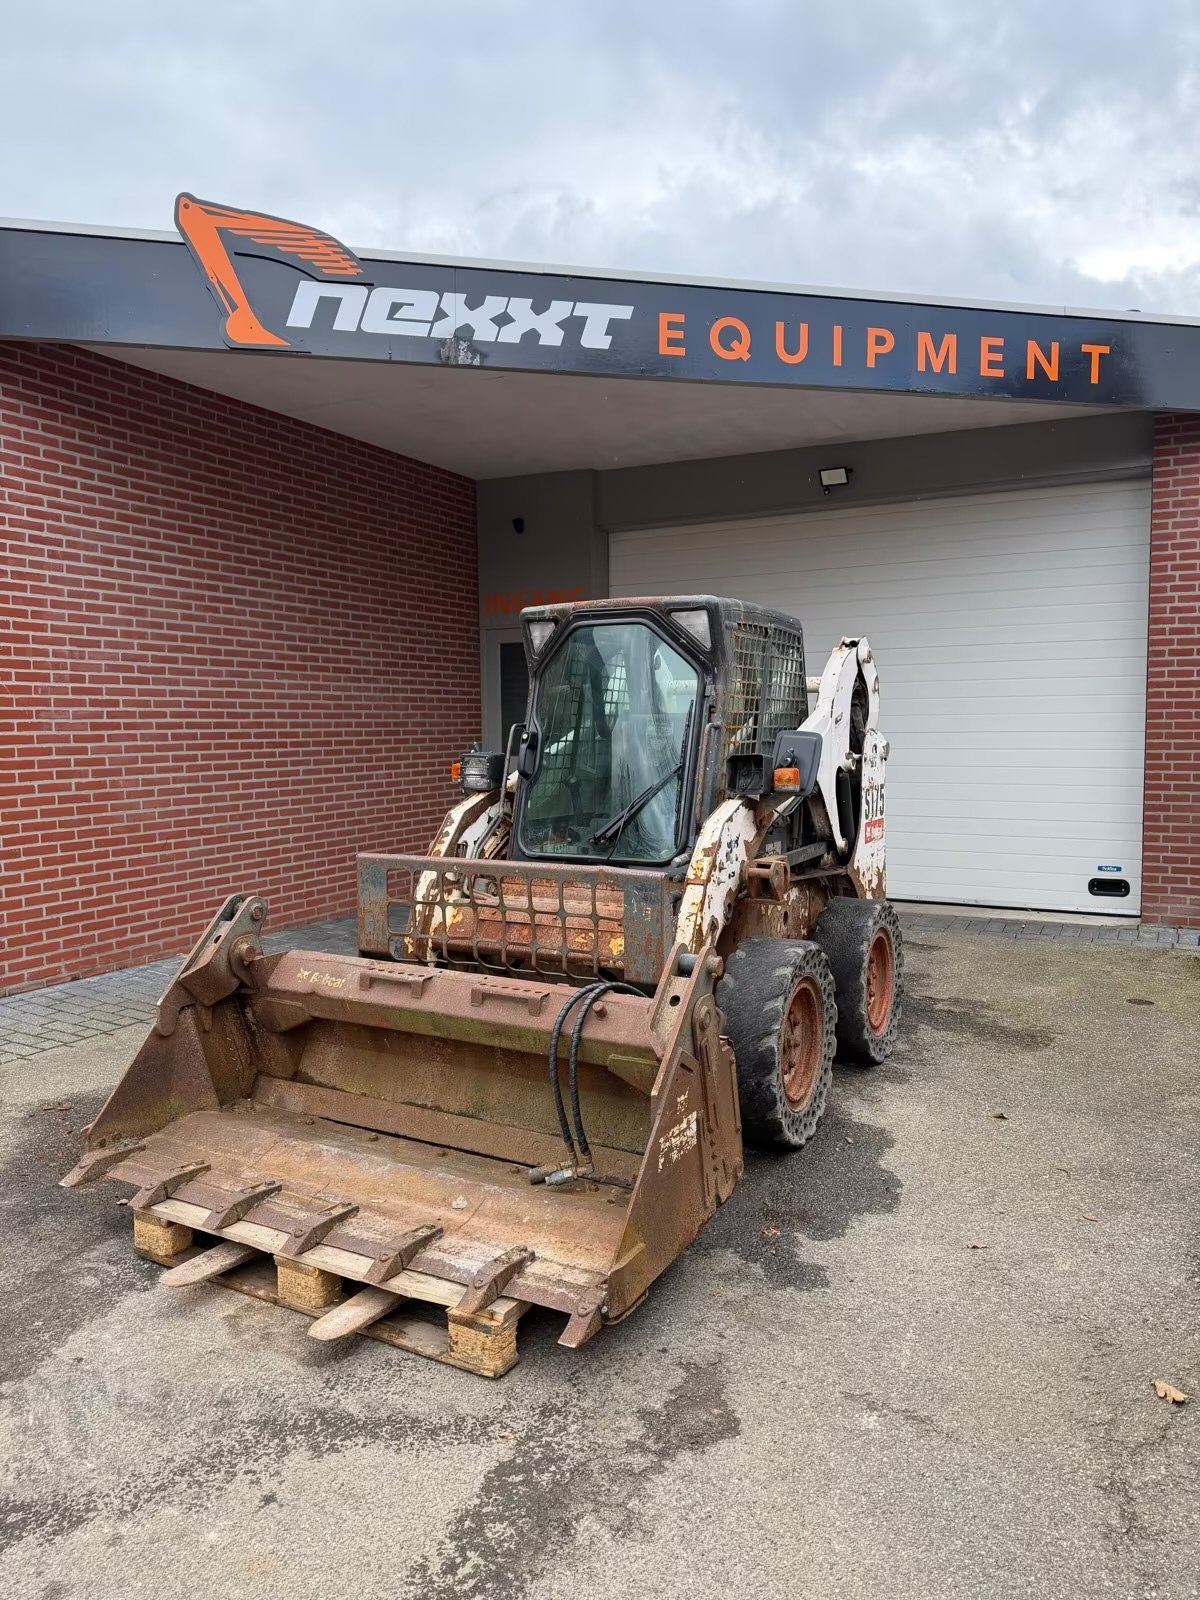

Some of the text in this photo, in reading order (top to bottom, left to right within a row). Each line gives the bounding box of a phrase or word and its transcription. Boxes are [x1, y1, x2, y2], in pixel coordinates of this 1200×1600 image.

[286, 280, 1110, 385] nexxt EQUIPMENT
[309, 972, 346, 989] Bbcat
